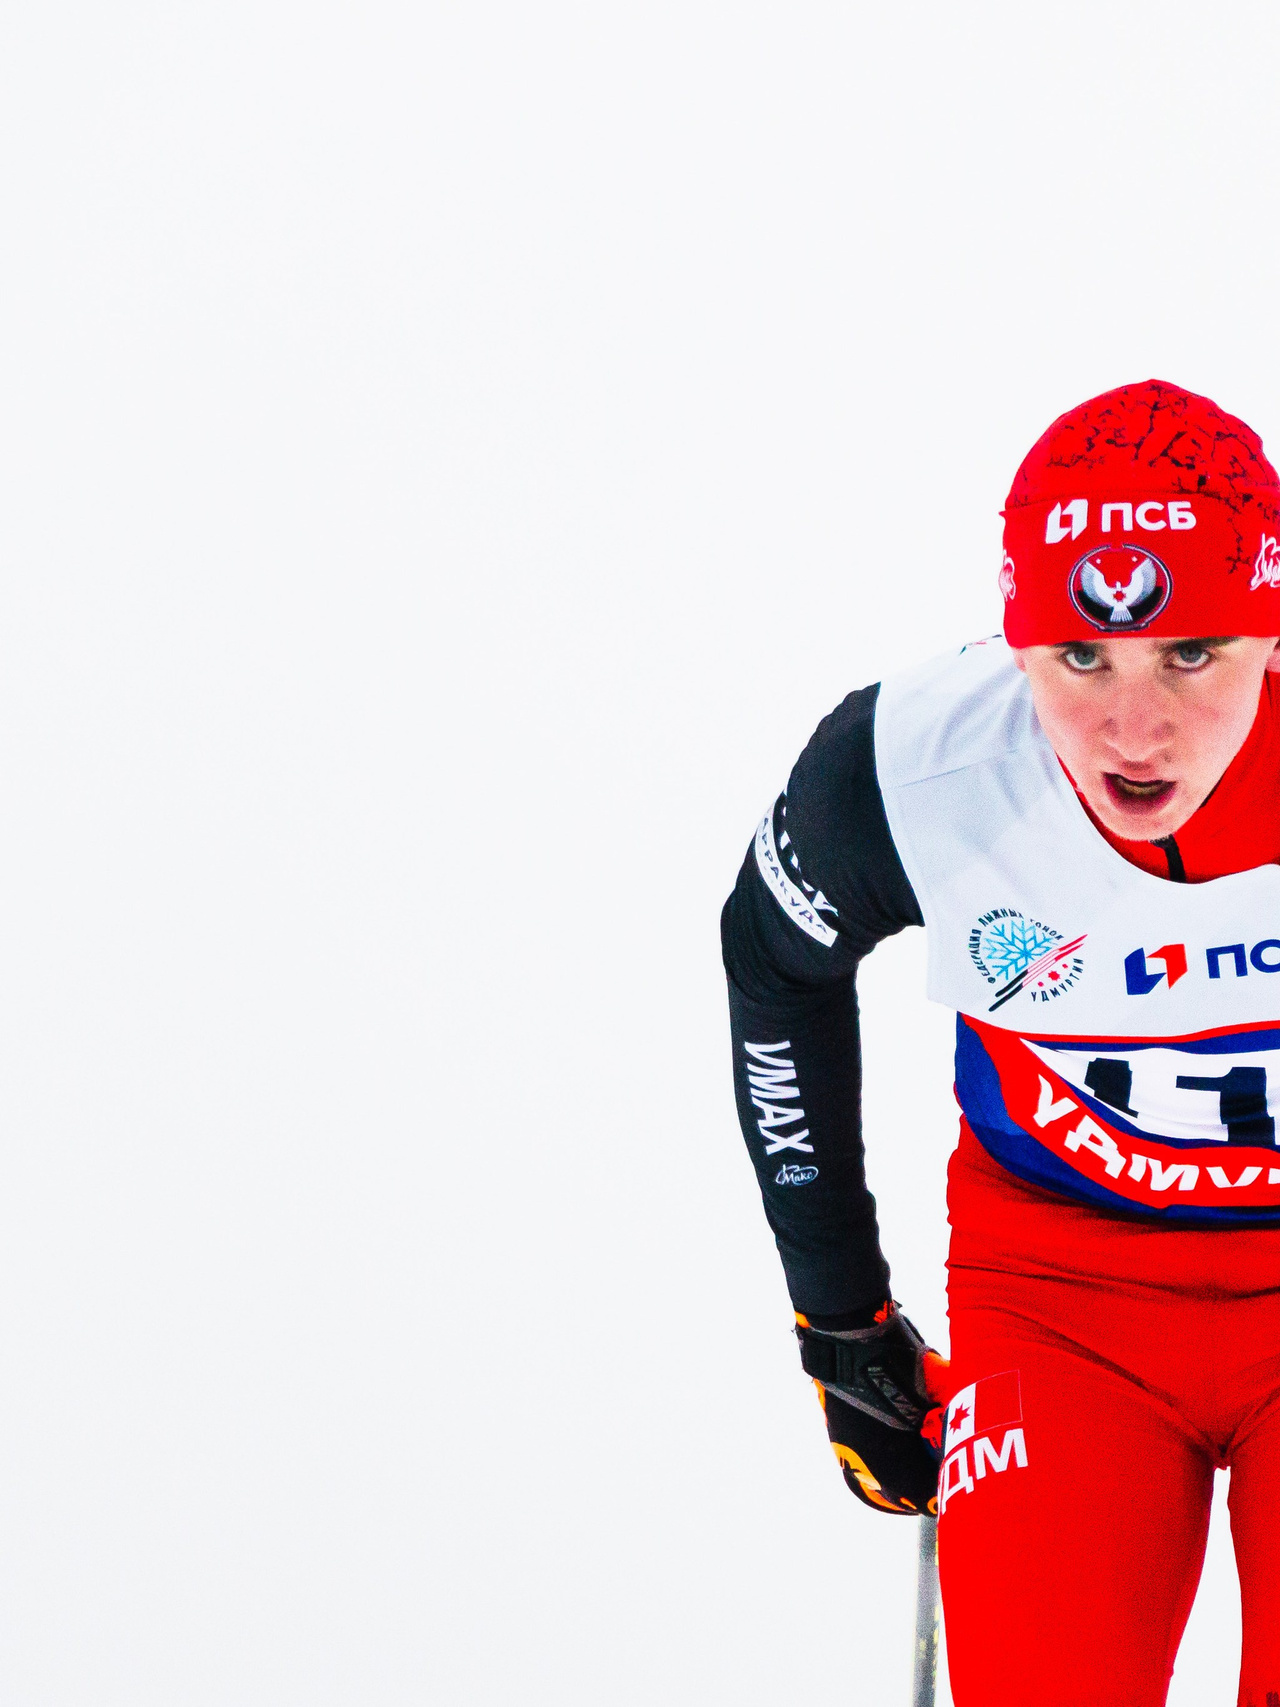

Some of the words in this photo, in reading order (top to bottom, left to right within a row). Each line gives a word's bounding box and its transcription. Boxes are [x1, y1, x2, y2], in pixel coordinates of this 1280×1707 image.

[1101, 500, 1197, 533] ПСБ
[1029, 918, 1064, 940] ОНОК
[1031, 957, 1084, 1002] УДМУРТИИ
[744, 1040, 815, 1156] VMAX
[938, 1428, 1028, 1515] ДМ
